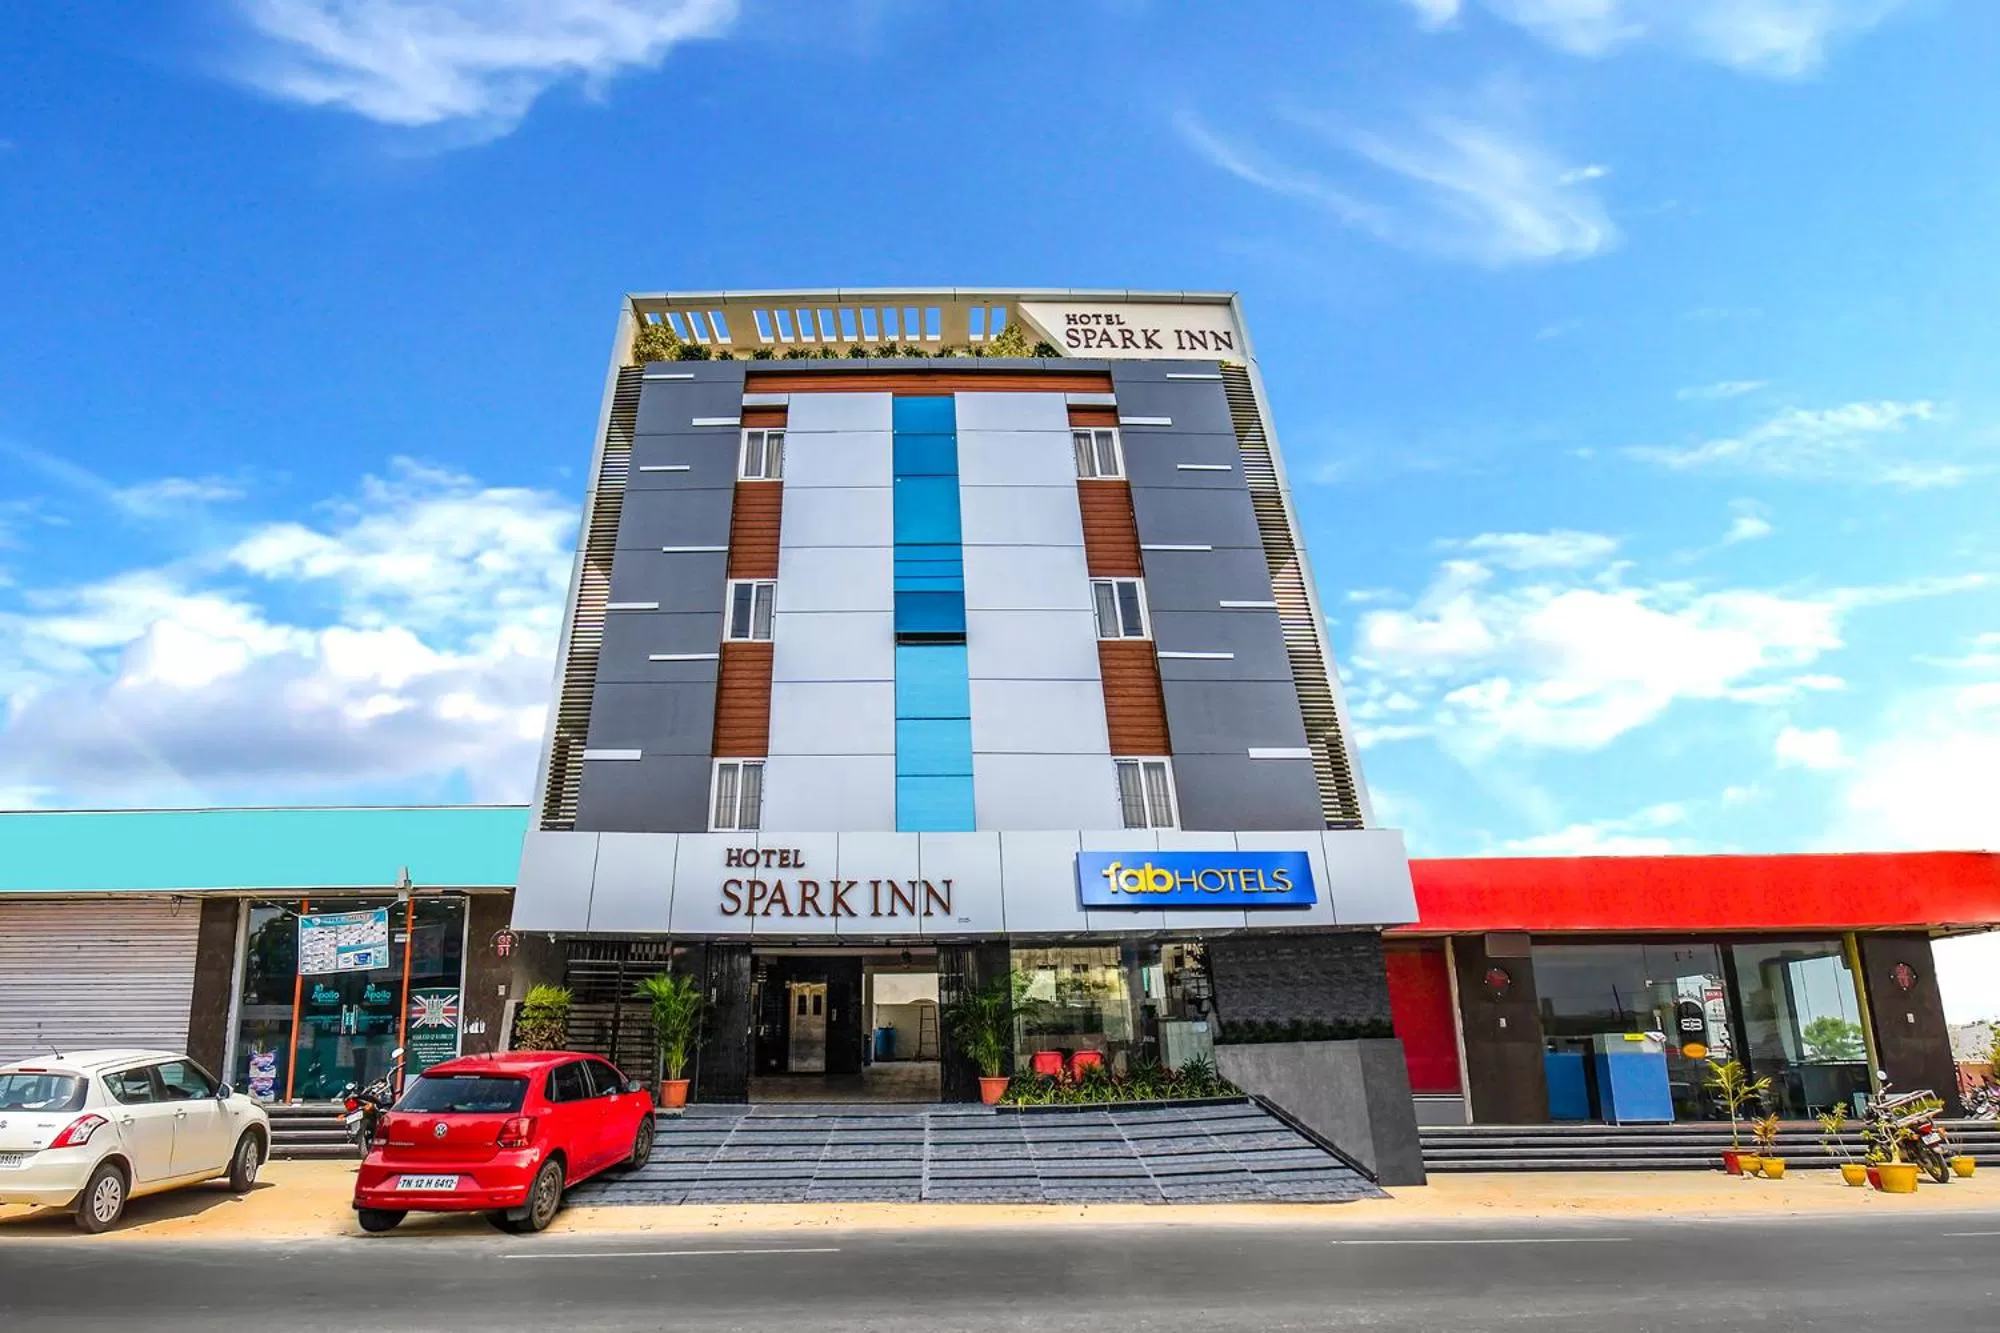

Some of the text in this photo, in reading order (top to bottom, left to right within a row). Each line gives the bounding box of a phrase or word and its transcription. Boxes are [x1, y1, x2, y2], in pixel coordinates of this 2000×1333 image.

[1065, 314, 1125, 326] HOTEL
[1066, 328, 1234, 351] SPARK INN
[726, 848, 805, 868] HOTEL
[1102, 861, 1294, 895] fabHOTELS
[720, 879, 953, 917] SPARK INN
[312, 990, 340, 1002] Apollo
[364, 990, 391, 1002] Apollo
[401, 1179, 412, 1188] TN
[415, 1179, 424, 1188] 12
[434, 1179, 454, 1188] 6412
